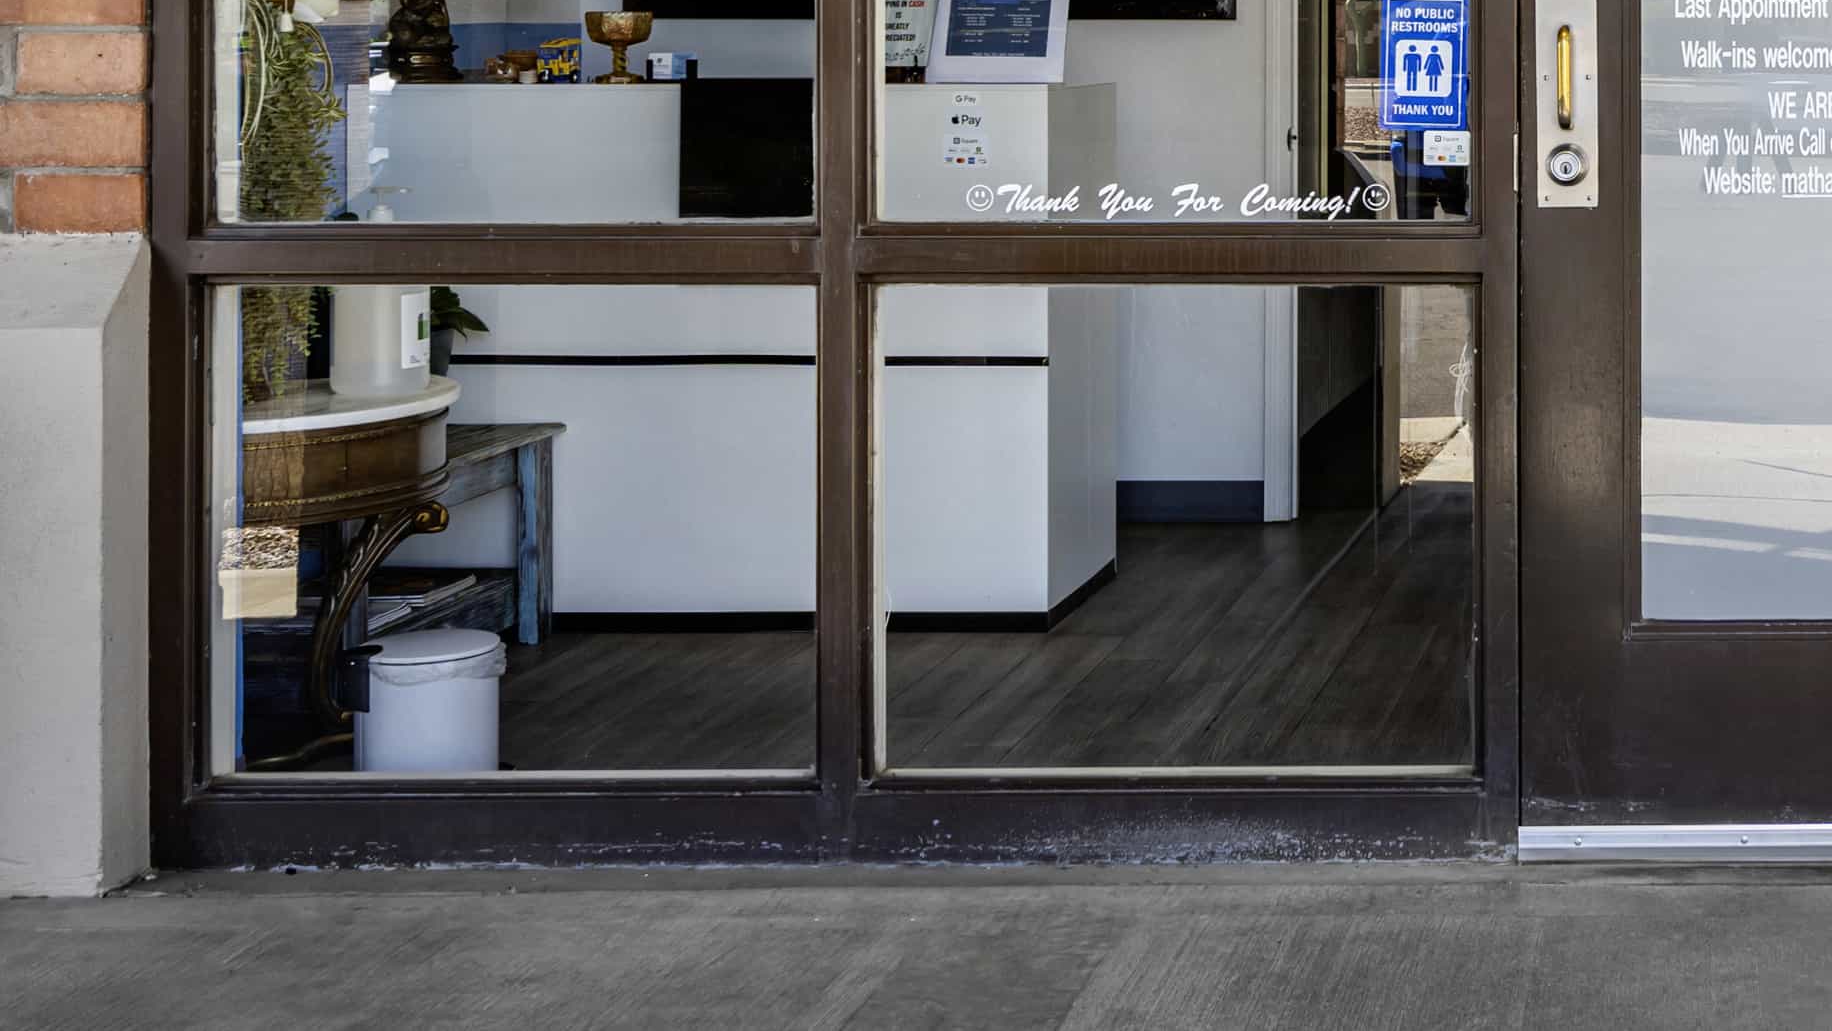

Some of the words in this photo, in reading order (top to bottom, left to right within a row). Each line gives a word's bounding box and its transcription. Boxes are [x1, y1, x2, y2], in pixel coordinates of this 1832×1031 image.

[1391, 21, 1458, 34] RESTROOMS
[1395, 7, 1412, 19] NO
[1414, 7, 1455, 20] PUBLIC
[1681, 41, 1757, 69] Walk-ins
[1392, 103, 1428, 116] THANK
[1431, 104, 1454, 117] YOU
[1768, 91, 1797, 119] WE
[961, 114, 982, 127] Pay
[1679, 127, 1719, 156] When
[1723, 127, 1749, 156] You
[1754, 127, 1795, 156] Arrive
[1799, 127, 1826, 156] Call
[1703, 166, 1776, 195] Website:
[996, 183, 1081, 215] Thank
[1098, 183, 1154, 220] You
[1171, 183, 1223, 217] For
[1240, 183, 1359, 220] Coming!
